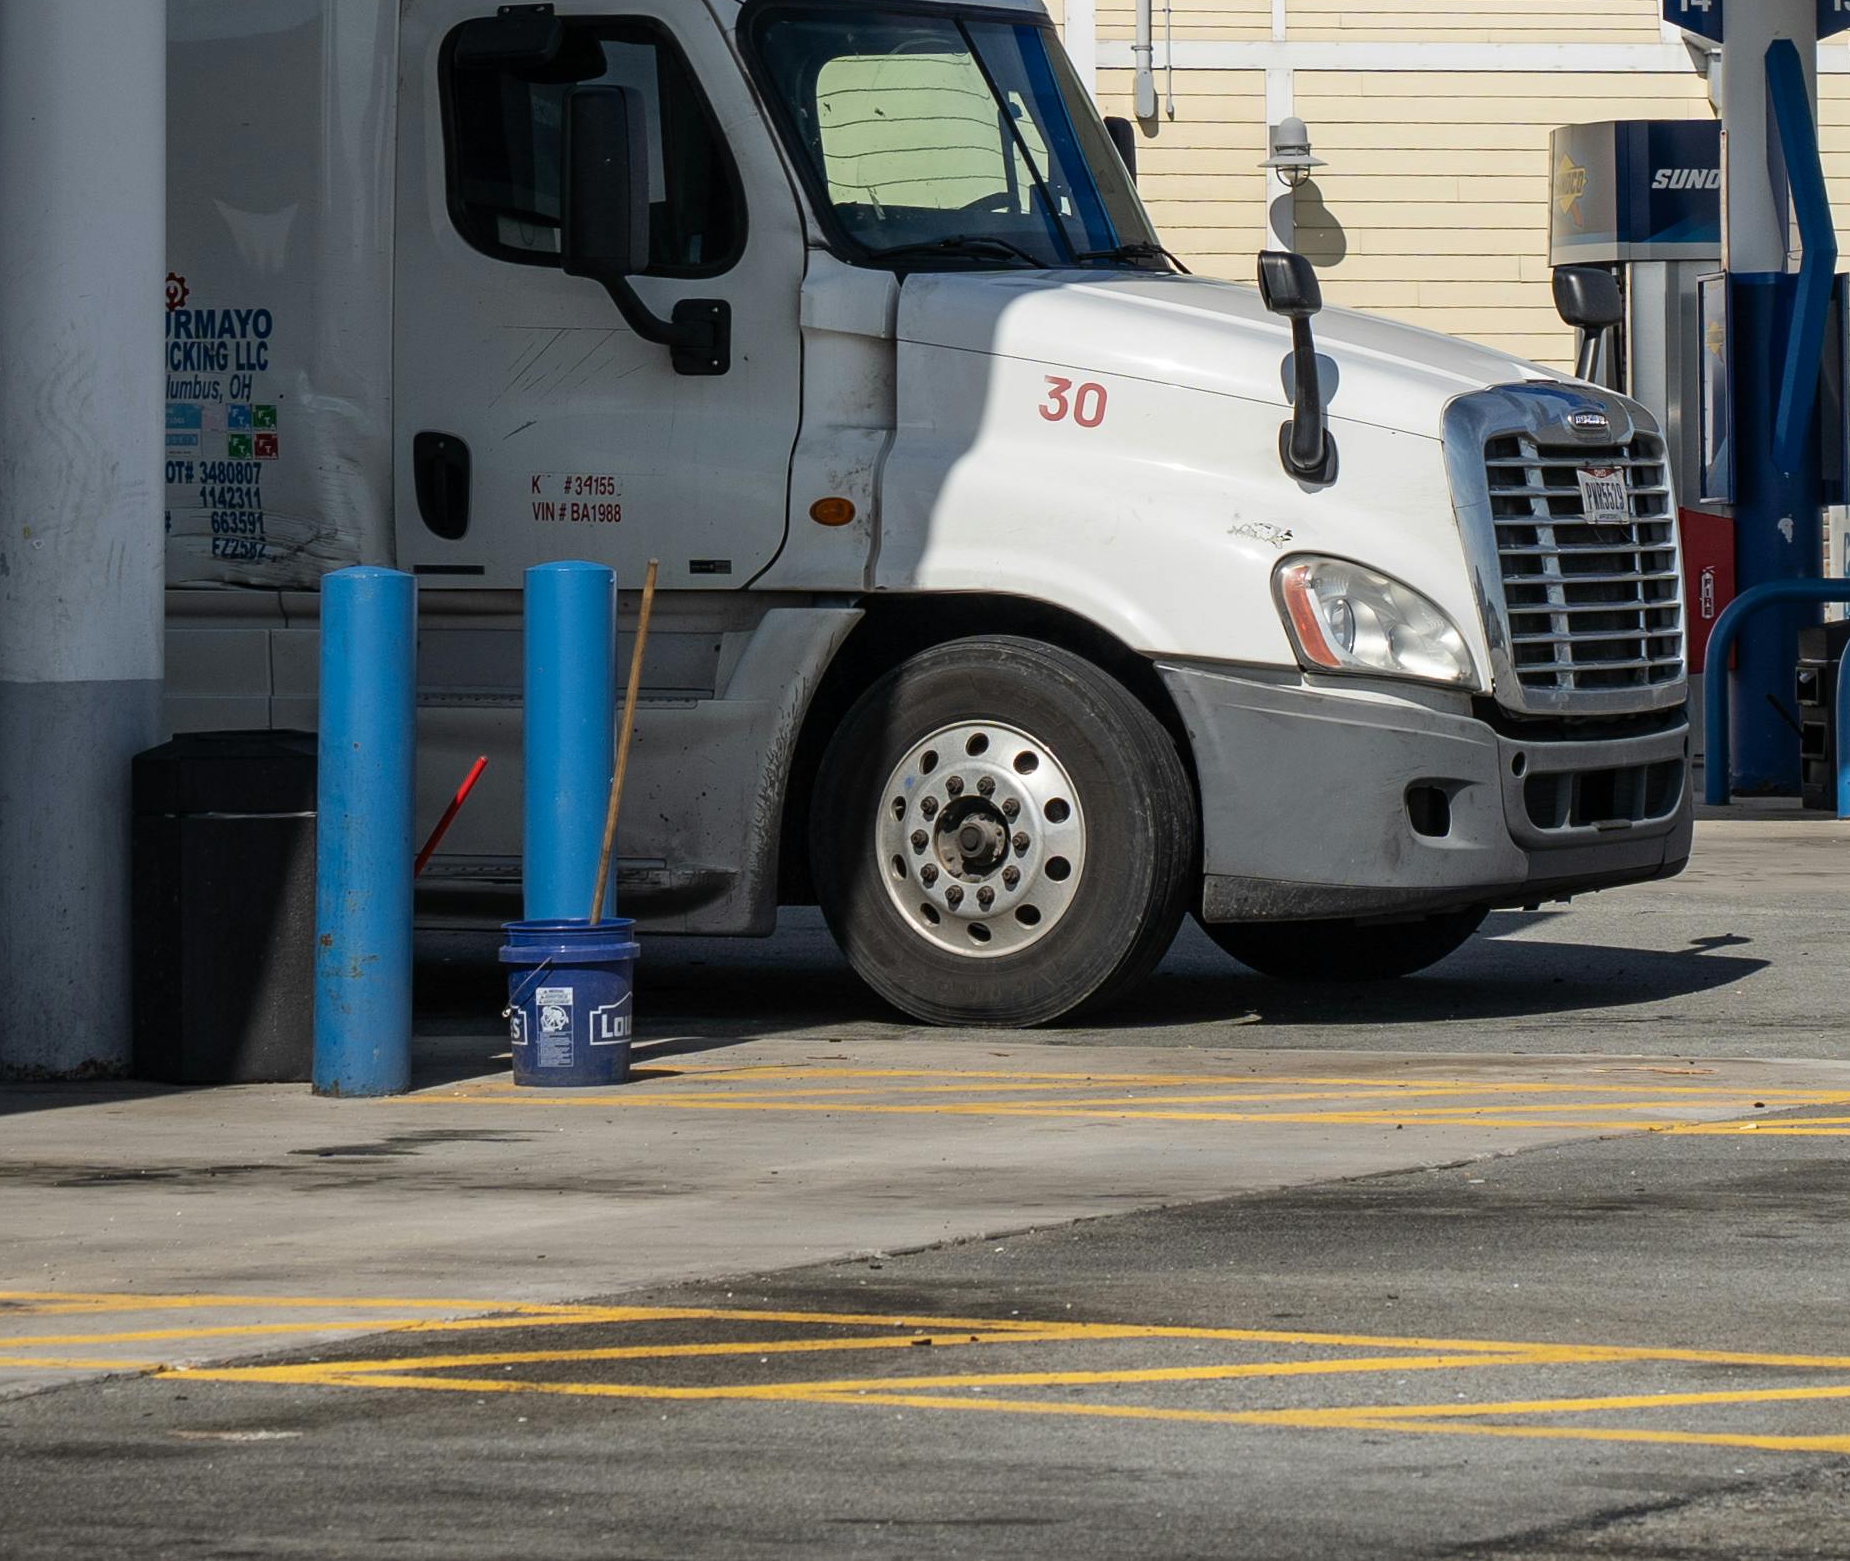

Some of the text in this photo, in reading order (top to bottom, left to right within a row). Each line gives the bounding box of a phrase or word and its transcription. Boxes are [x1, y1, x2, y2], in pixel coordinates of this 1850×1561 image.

[235, 340, 269, 372] LLC
[230, 373, 253, 401] OH
[1038, 374, 1108, 429] 30
[199, 460, 262, 485] 3480807
[199, 485, 262, 510] 1142311
[211, 510, 264, 534] 663591
[532, 501, 555, 522] VIN
[1704, 578, 1712, 616] FIRE
